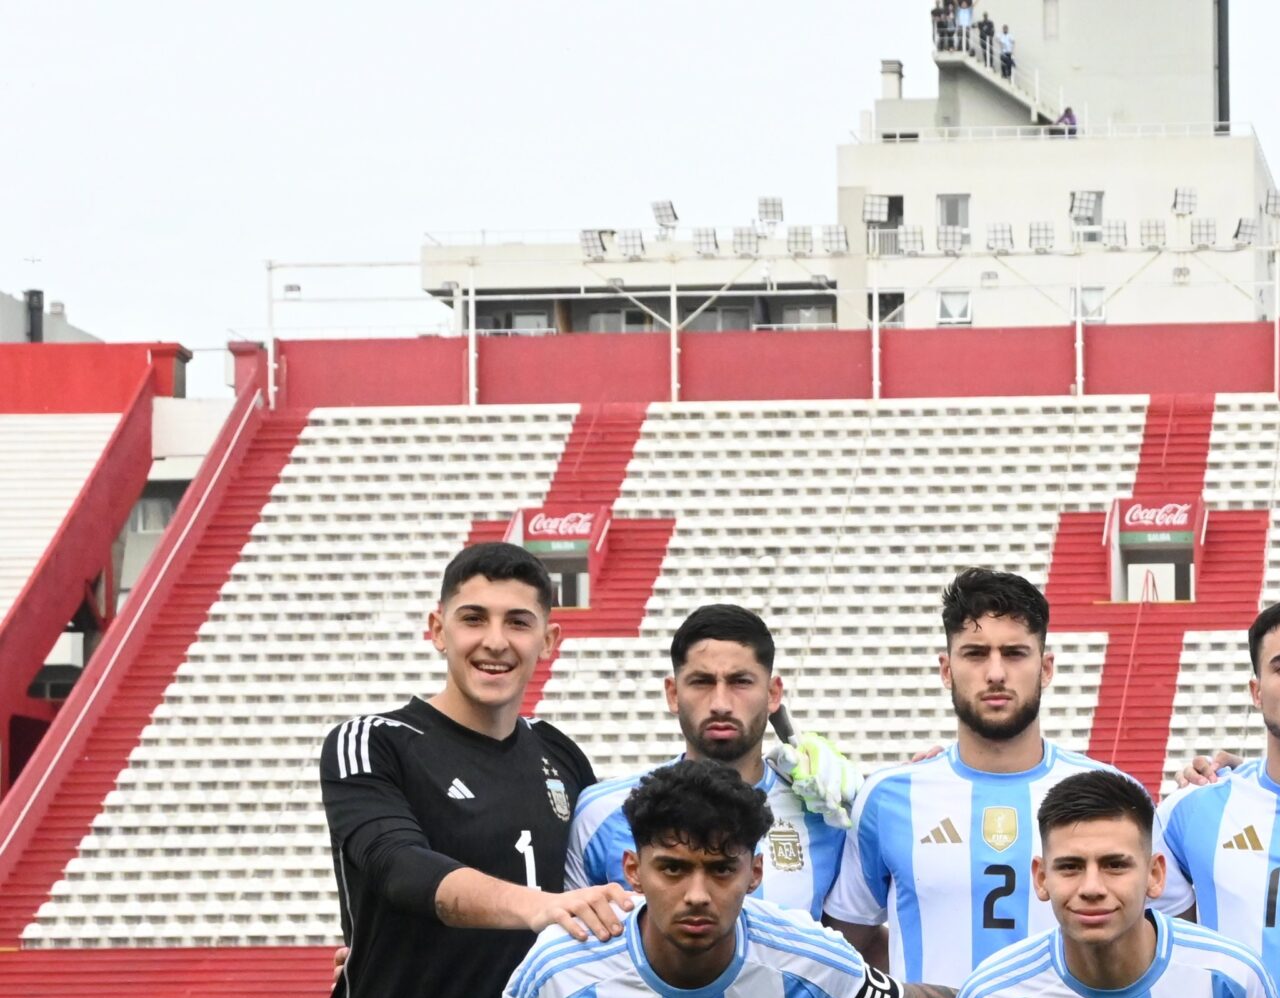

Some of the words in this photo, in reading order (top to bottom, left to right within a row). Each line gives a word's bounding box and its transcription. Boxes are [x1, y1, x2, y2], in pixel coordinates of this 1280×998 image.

[528, 512, 596, 536] Coca-Cola
[1125, 503, 1191, 526] Coca-Cola
[515, 830, 541, 891] 1
[778, 842, 796, 860] AFA
[983, 864, 1016, 929] 2
